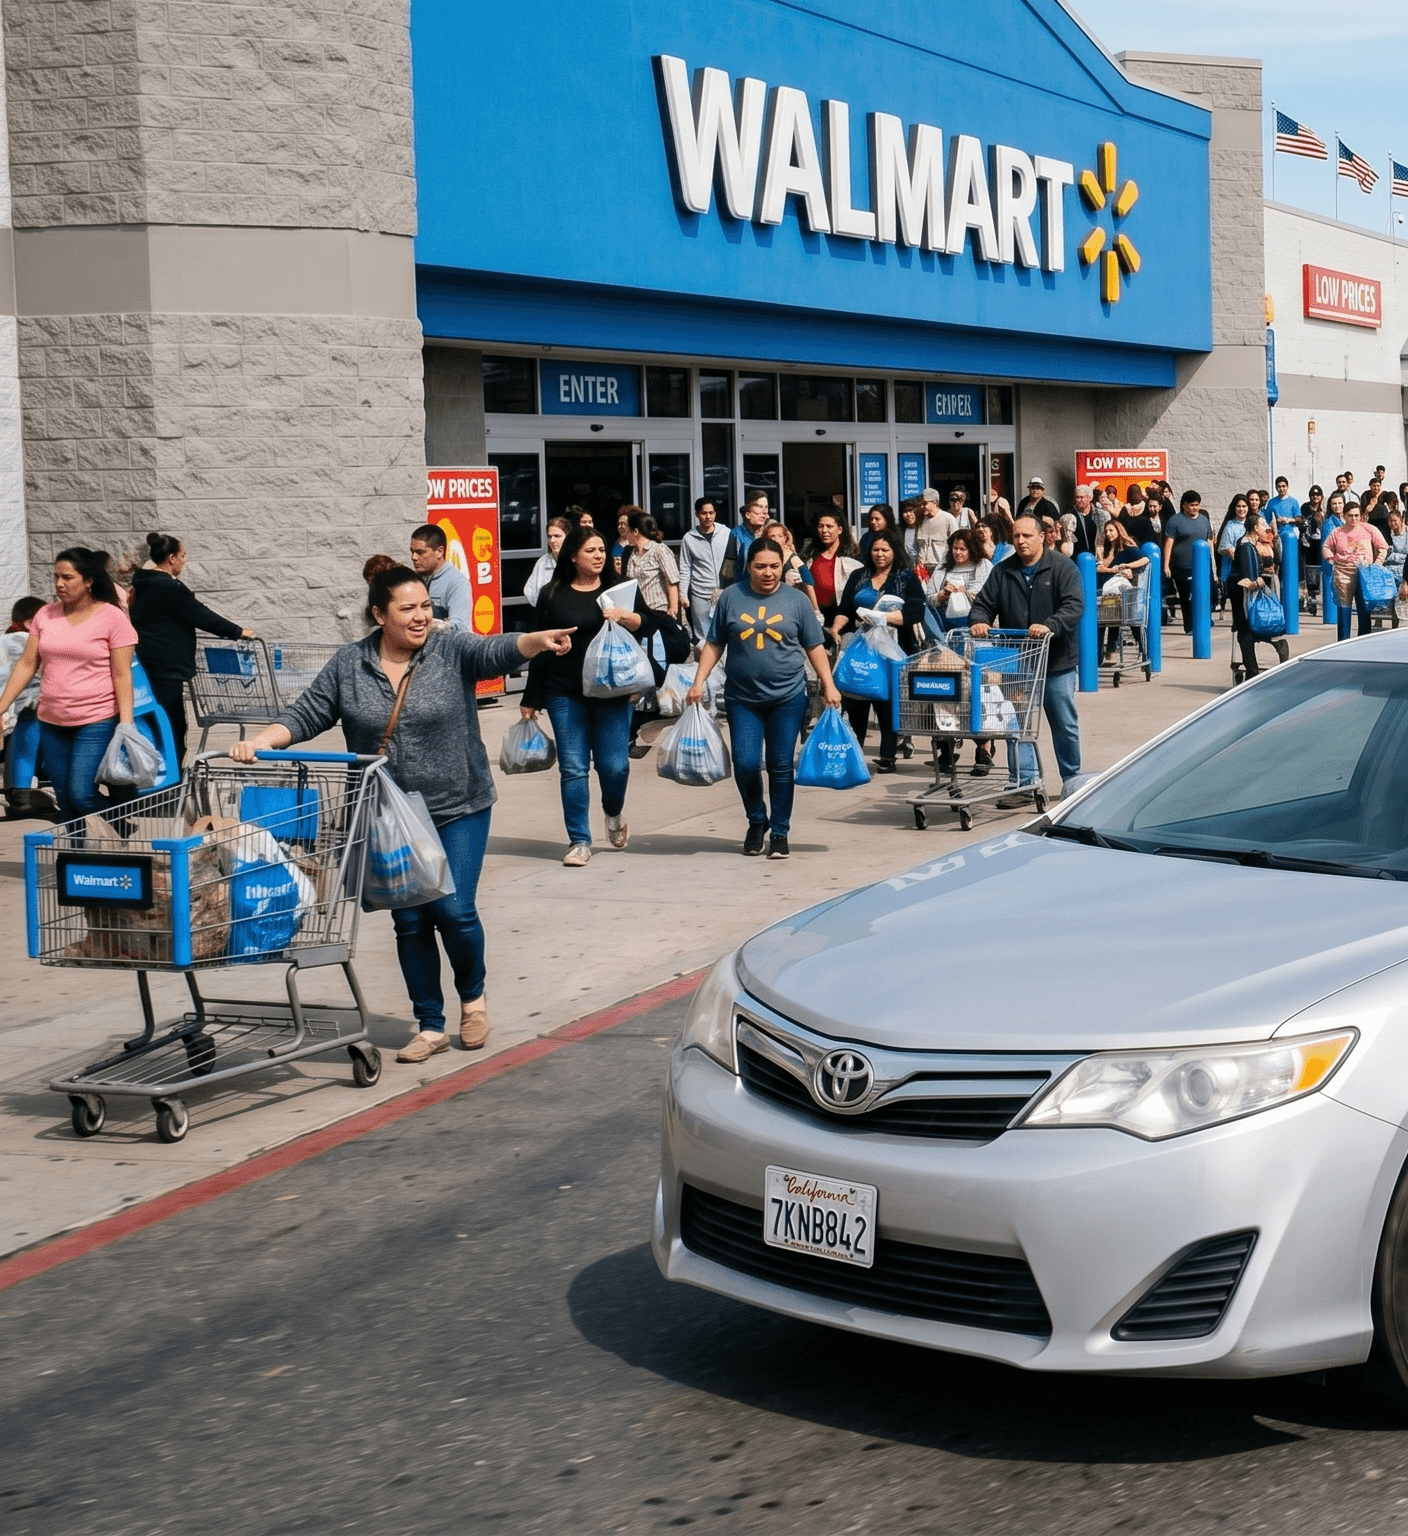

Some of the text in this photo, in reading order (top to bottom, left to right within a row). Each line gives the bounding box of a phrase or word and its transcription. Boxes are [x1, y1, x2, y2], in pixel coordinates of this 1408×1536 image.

[653, 54, 1074, 272] WALMART
[1315, 274, 1376, 314] LOW PRICES
[559, 374, 620, 404] ENTER
[1086, 456, 1160, 470] LOW PRICES
[448, 478, 493, 498] PRICES
[73, 874, 118, 887] Walmart
[787, 1176, 855, 1206] California
[771, 1197, 867, 1256] 7KNB842
